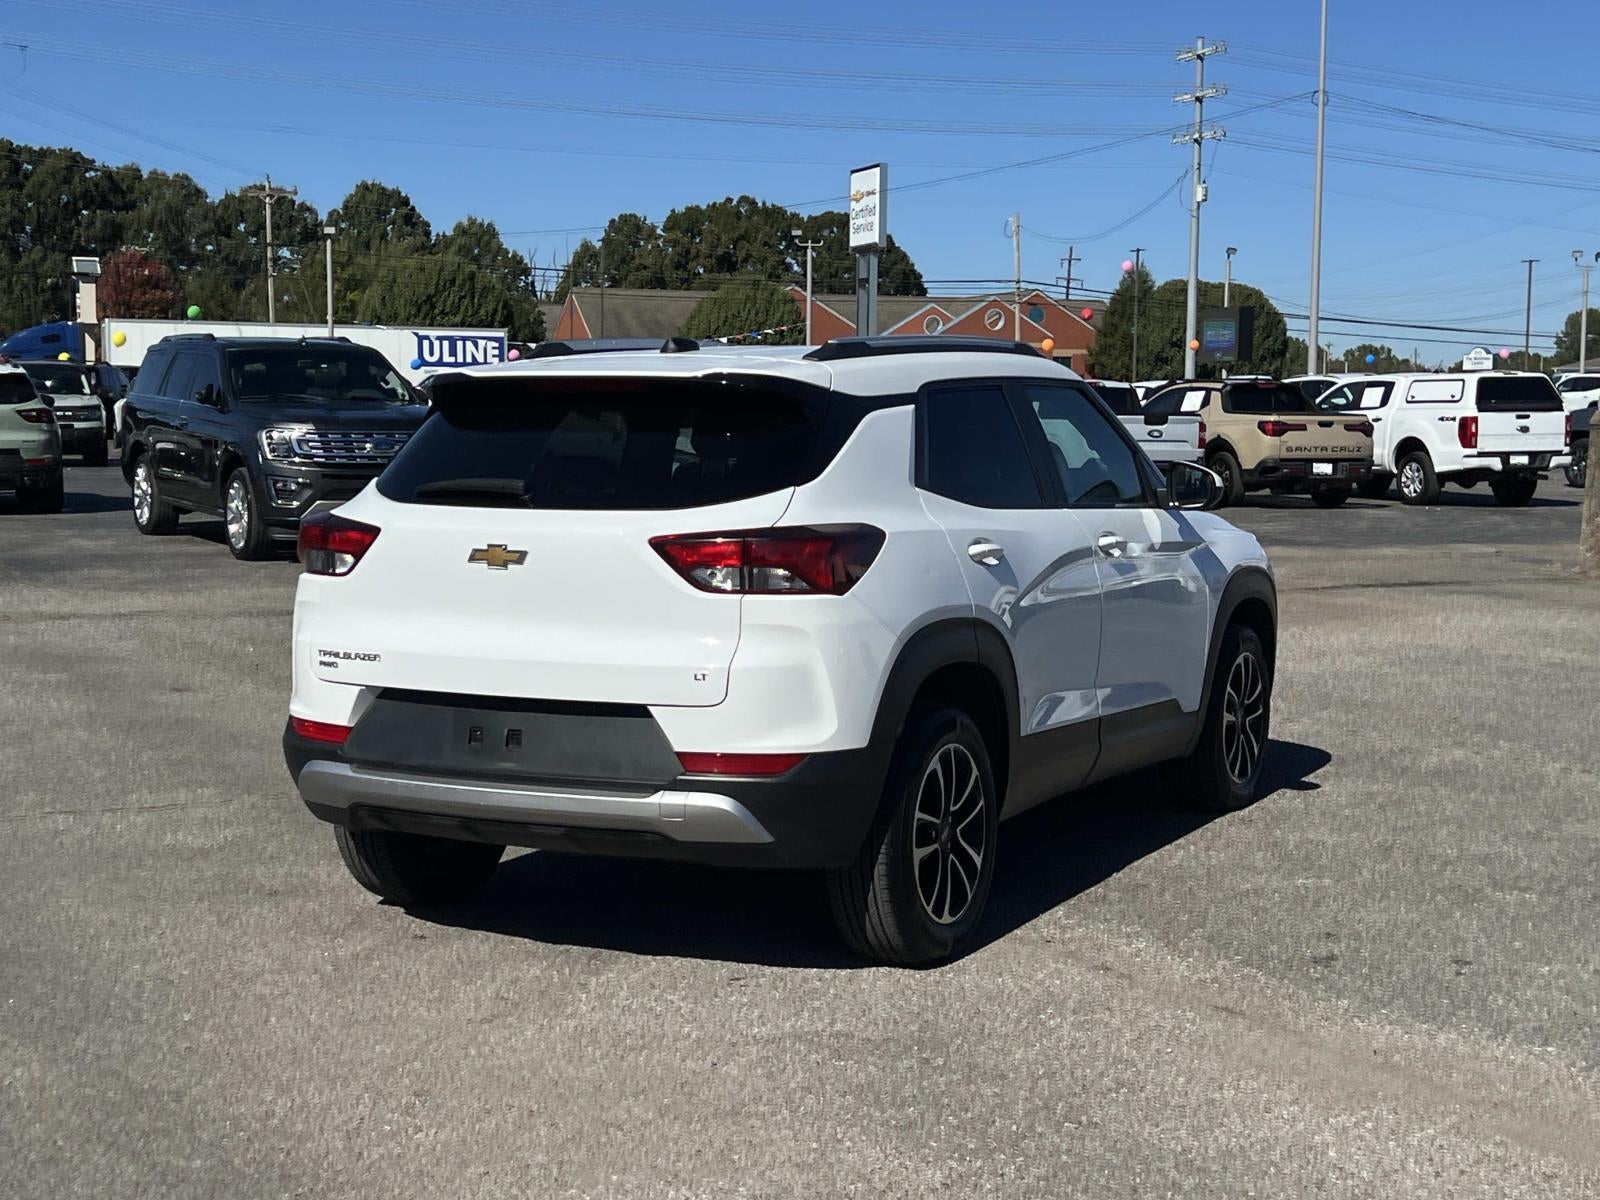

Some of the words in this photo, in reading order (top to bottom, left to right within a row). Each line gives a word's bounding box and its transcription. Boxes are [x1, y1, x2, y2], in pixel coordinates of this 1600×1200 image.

[850, 203, 876, 221] Certified
[852, 221, 874, 235] Service
[422, 339, 500, 363] ULINE
[318, 649, 381, 662] TRAILBLAZER
[694, 673, 709, 681] LT
